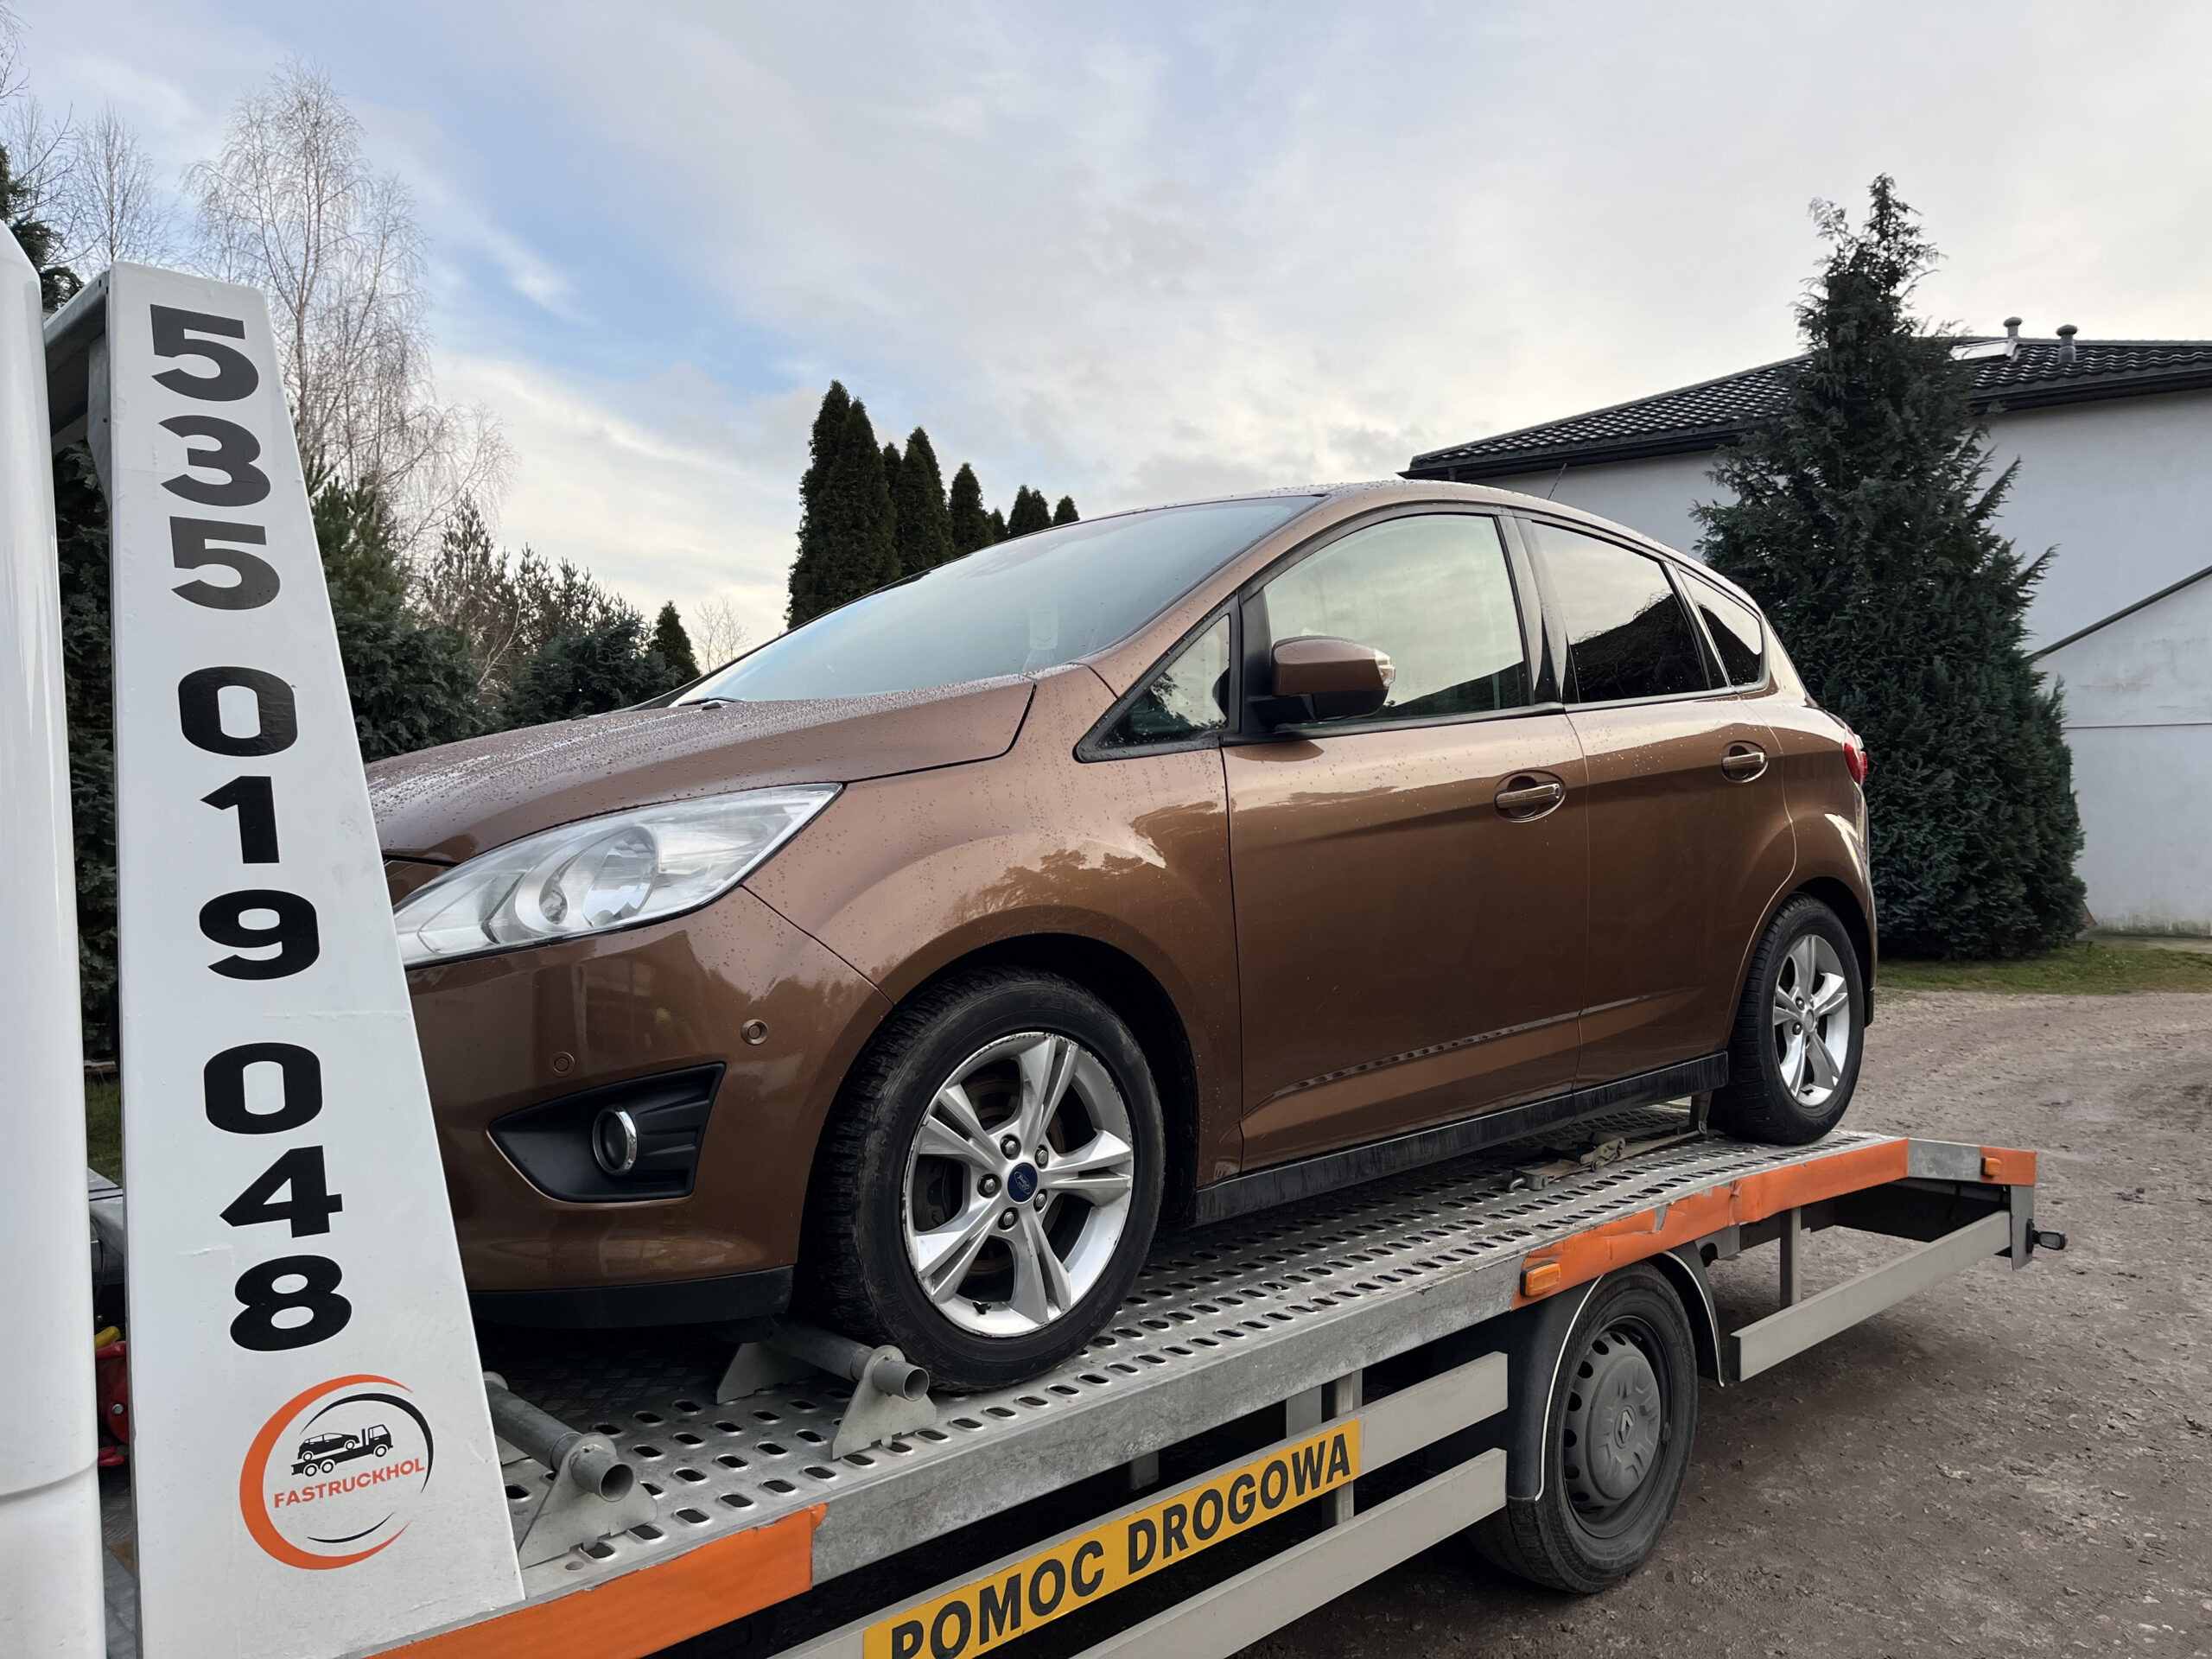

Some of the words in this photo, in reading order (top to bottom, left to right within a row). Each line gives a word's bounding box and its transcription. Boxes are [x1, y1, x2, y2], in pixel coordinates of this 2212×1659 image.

[150, 303, 281, 611] 535
[177, 665, 321, 981] 019
[203, 1042, 353, 1352] 048
[274, 1458, 425, 1509] FASTRUCKHOL
[891, 1540, 1105, 1659] POMOC
[1128, 1433, 1351, 1576] DROGOWA
